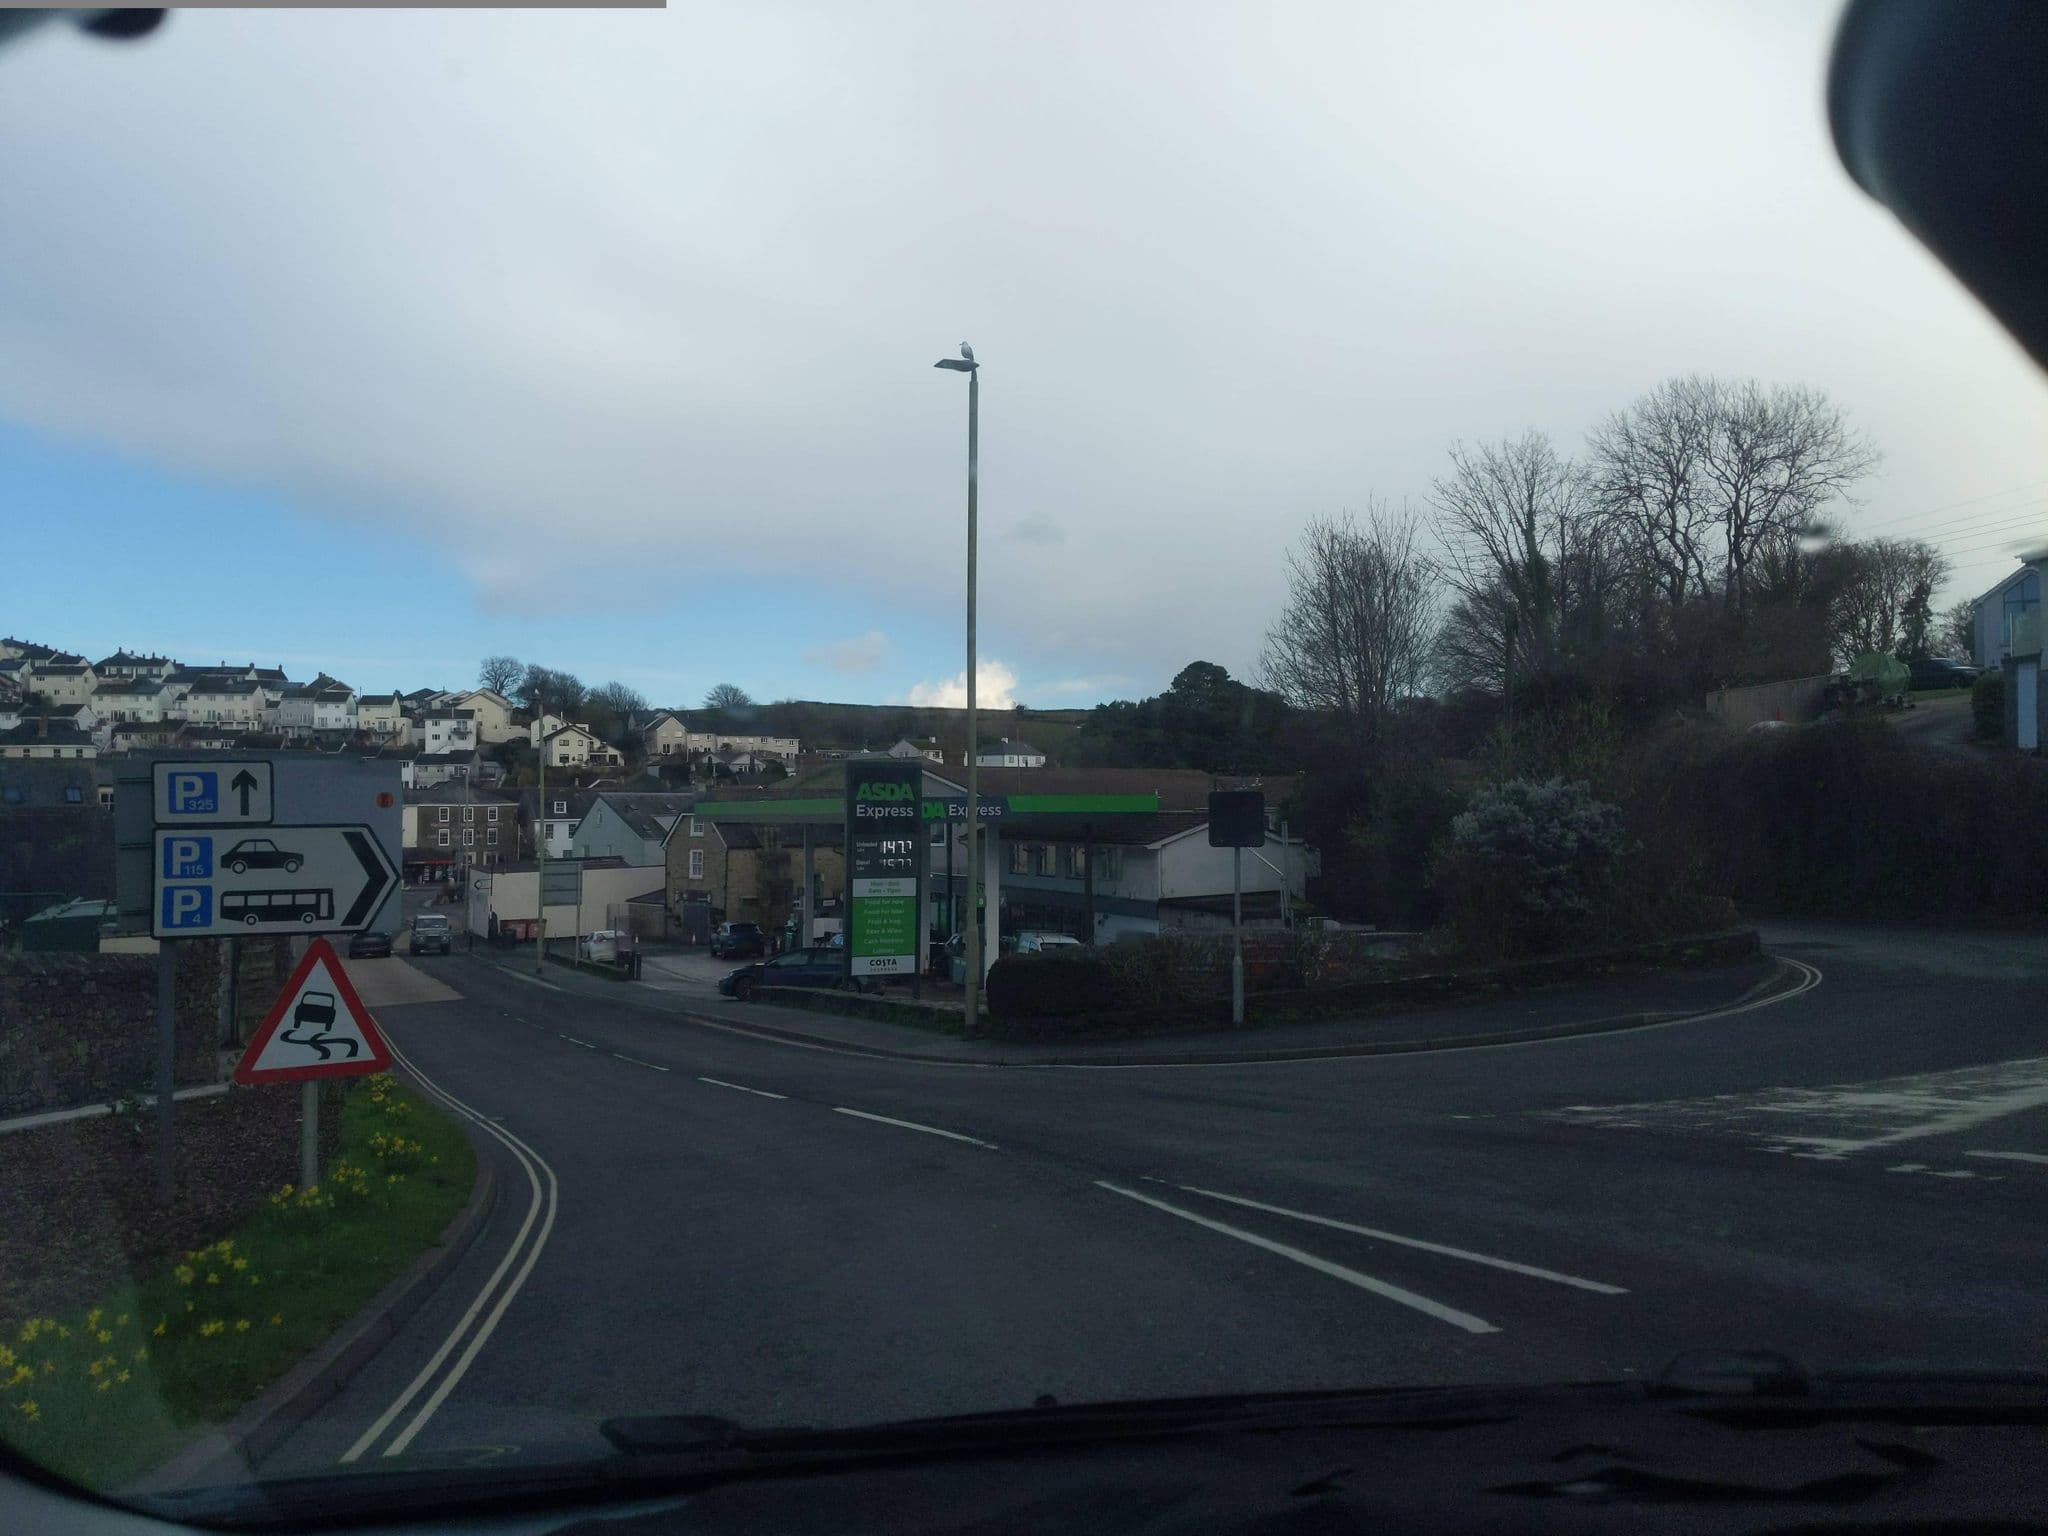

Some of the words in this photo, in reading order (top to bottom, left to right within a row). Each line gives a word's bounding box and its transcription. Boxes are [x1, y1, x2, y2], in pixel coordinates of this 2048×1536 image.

[176, 776, 203, 810] P
[856, 782, 915, 801] ASDA
[188, 800, 214, 811] 325
[856, 804, 914, 819] Express
[172, 841, 200, 875] P
[185, 865, 204, 875] 115
[173, 889, 201, 924] P
[192, 915, 201, 924] 4
[869, 958, 897, 967] COSTA
